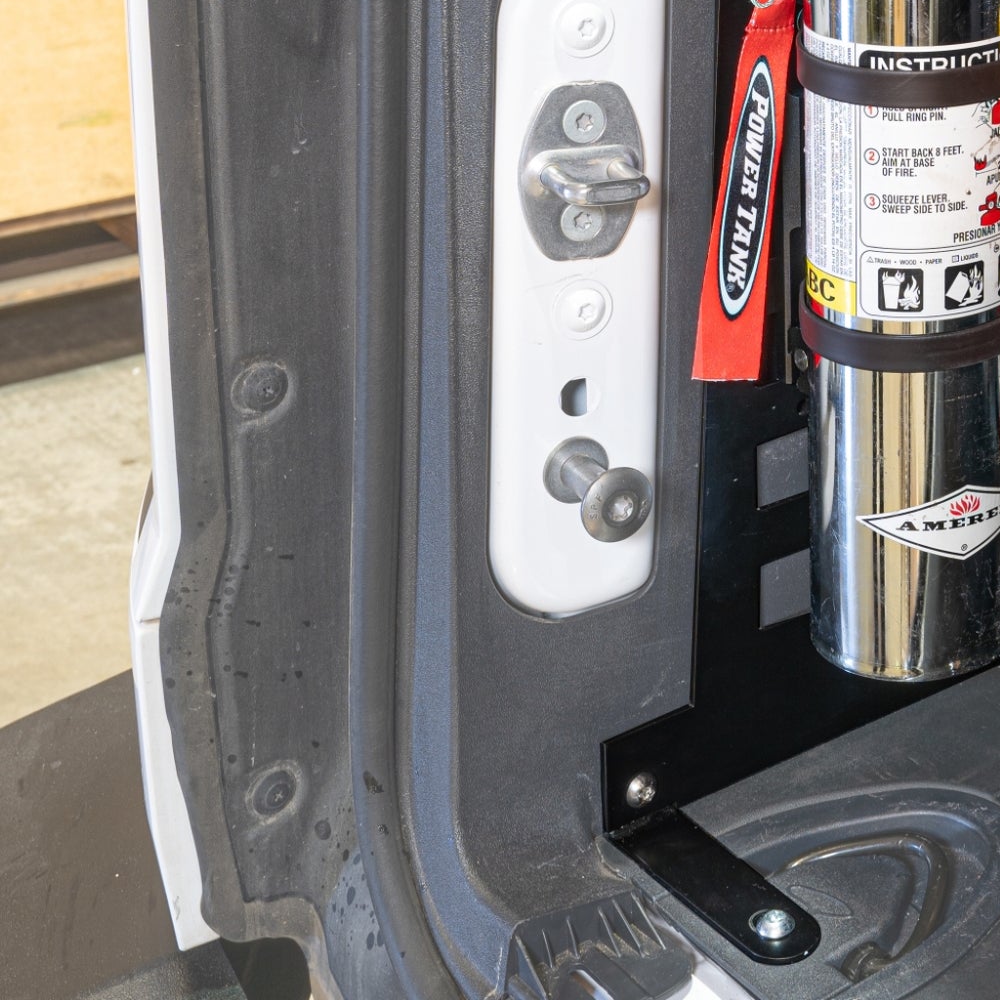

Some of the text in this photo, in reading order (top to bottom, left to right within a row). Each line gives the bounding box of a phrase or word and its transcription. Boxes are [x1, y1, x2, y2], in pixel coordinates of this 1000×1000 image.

[882, 111, 947, 122] PULL RING PIN.
[882, 145, 964, 157] START BACK 8 FEET.
[882, 157, 935, 167] AIM AT BASE
[882, 167, 917, 177] OF FIRE.
[728, 88, 769, 290] POWER TANK
[882, 194, 950, 205] SQUEEZE LEVER.
[882, 201, 968, 214] SWEEP SIDE TO SIDE.
[953, 223, 996, 243] PRESIONAR
[874, 257, 892, 265] TRASH
[807, 264, 836, 302] BC
